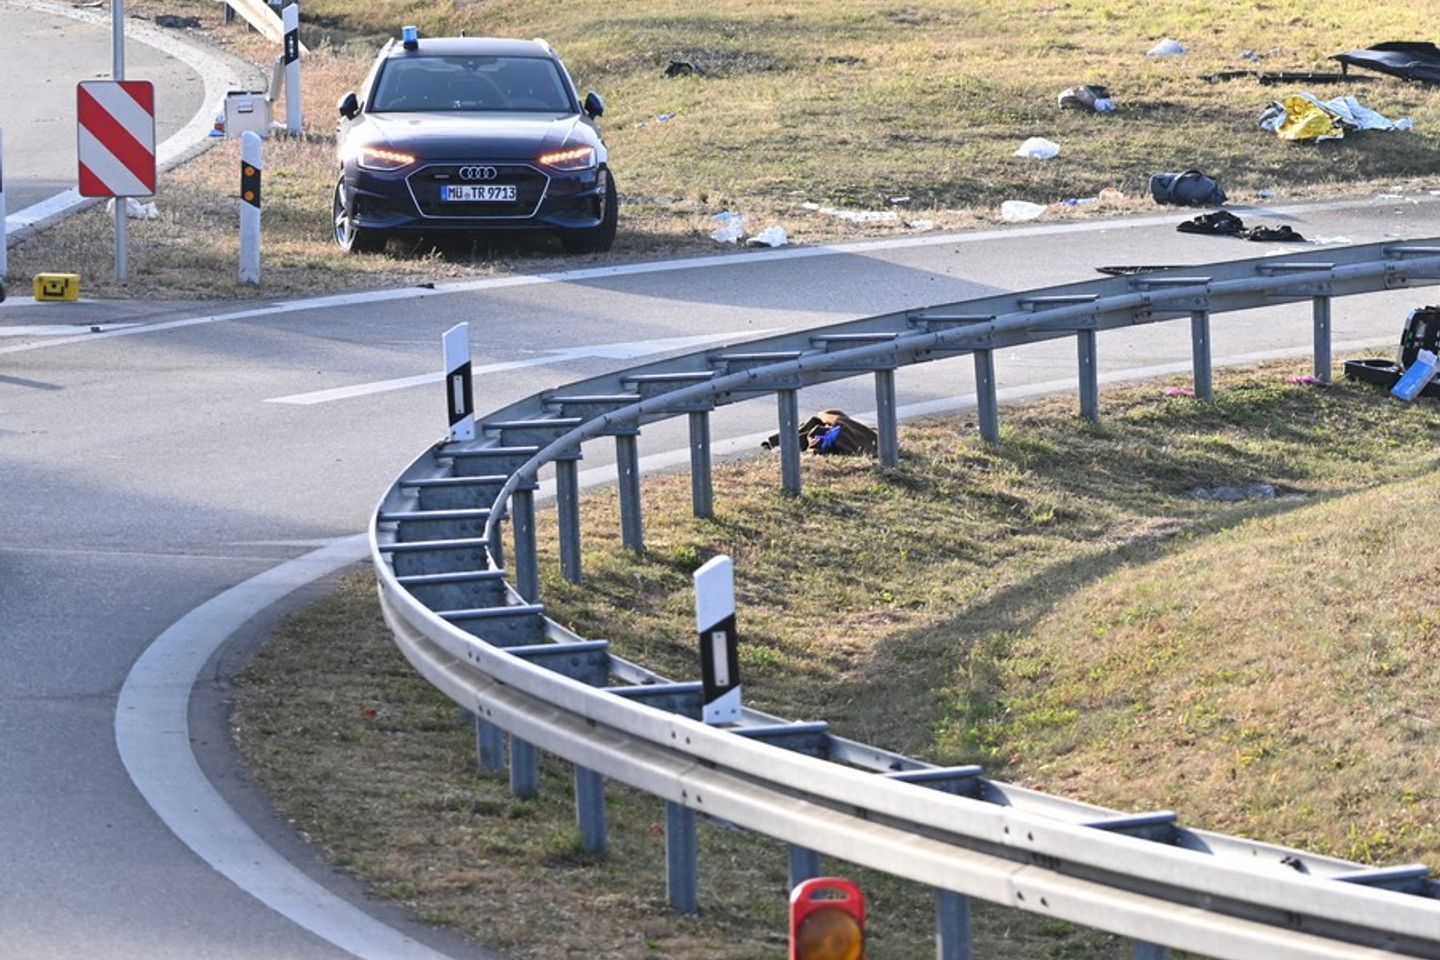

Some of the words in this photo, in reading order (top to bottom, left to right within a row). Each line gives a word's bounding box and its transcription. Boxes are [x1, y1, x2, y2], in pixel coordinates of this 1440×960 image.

[447, 186, 463, 199] MÜ
[472, 187, 485, 199] TR
[487, 187, 516, 199] 9713
